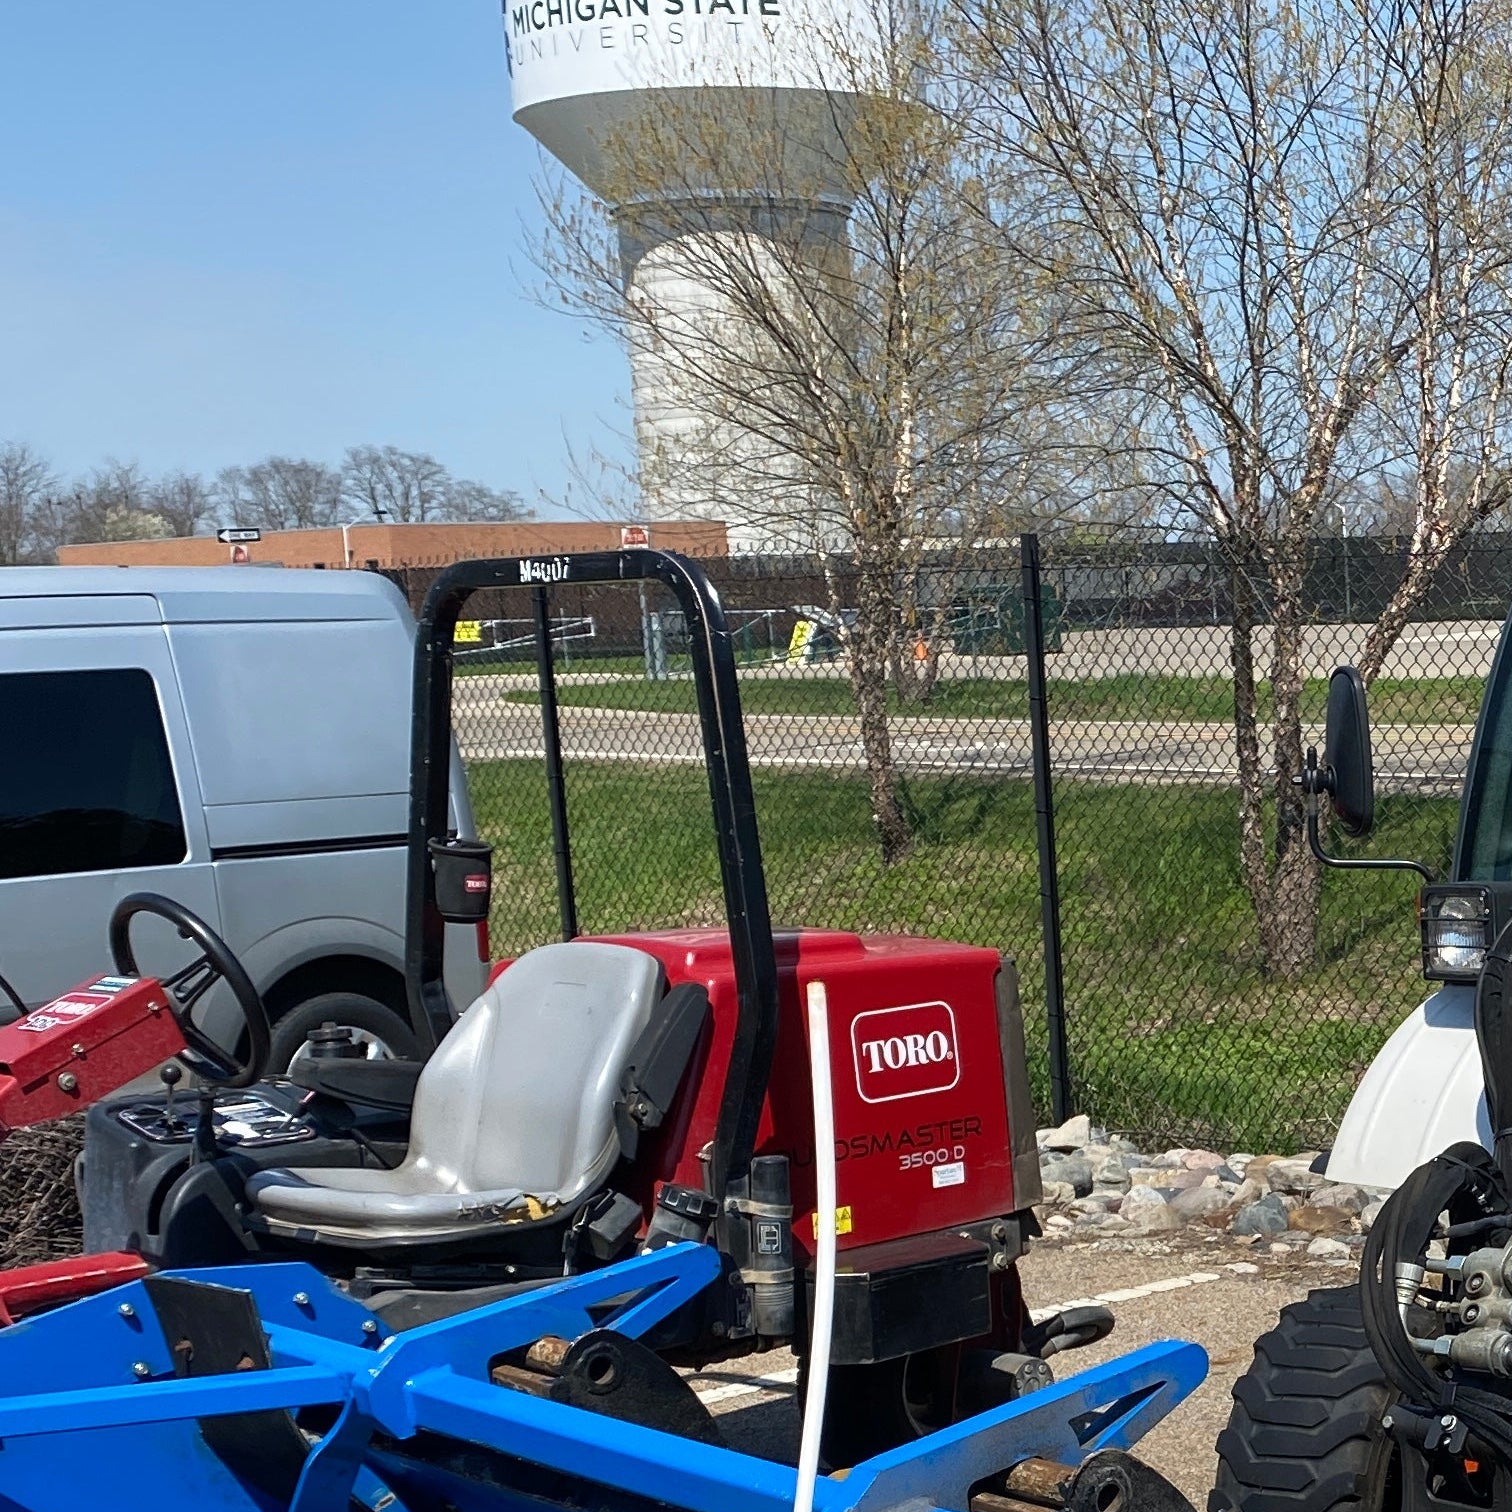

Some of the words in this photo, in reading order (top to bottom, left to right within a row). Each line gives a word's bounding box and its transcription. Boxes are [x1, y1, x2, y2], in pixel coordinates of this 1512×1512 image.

[512, 0, 649, 38] MICHIGAN
[862, 1030, 949, 1073] TORO
[898, 1148, 948, 1171] 3500
[953, 1145, 965, 1160] D
